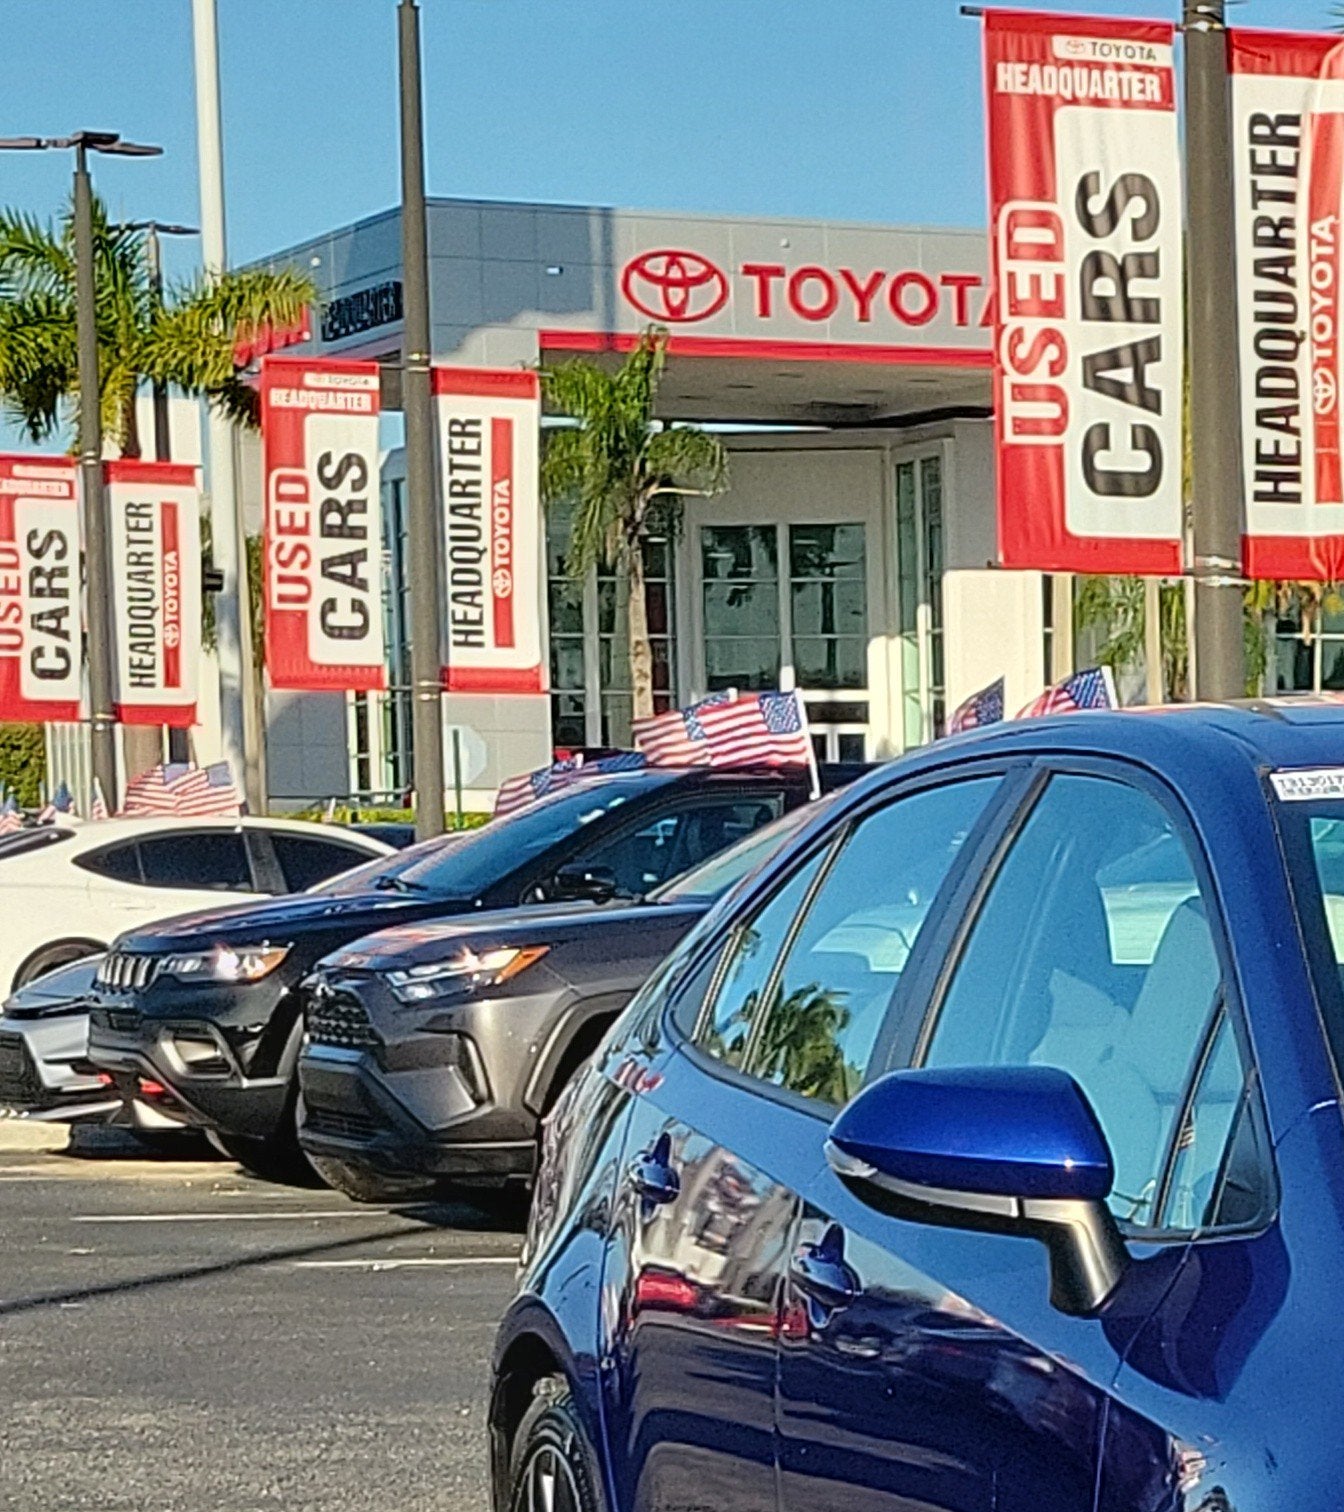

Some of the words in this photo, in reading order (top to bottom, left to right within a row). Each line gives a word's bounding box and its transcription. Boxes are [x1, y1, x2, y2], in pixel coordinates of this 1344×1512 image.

[996, 62, 1162, 102] HEADQUARTER
[1090, 41, 1158, 61] TOYOTA
[1005, 206, 1068, 441] USED
[1075, 169, 1164, 498] CARS
[1247, 111, 1306, 505] HEADQUARTER
[1310, 214, 1340, 358] TOYOTA
[125, 501, 159, 688] HEADQUARTER
[164, 551, 178, 627] TOYOTA
[275, 470, 311, 606] USED
[317, 451, 370, 640] CARS
[449, 417, 487, 648] HEADQUARTER
[492, 479, 511, 567] TOYOTA
[26, 528, 71, 680] CARS
